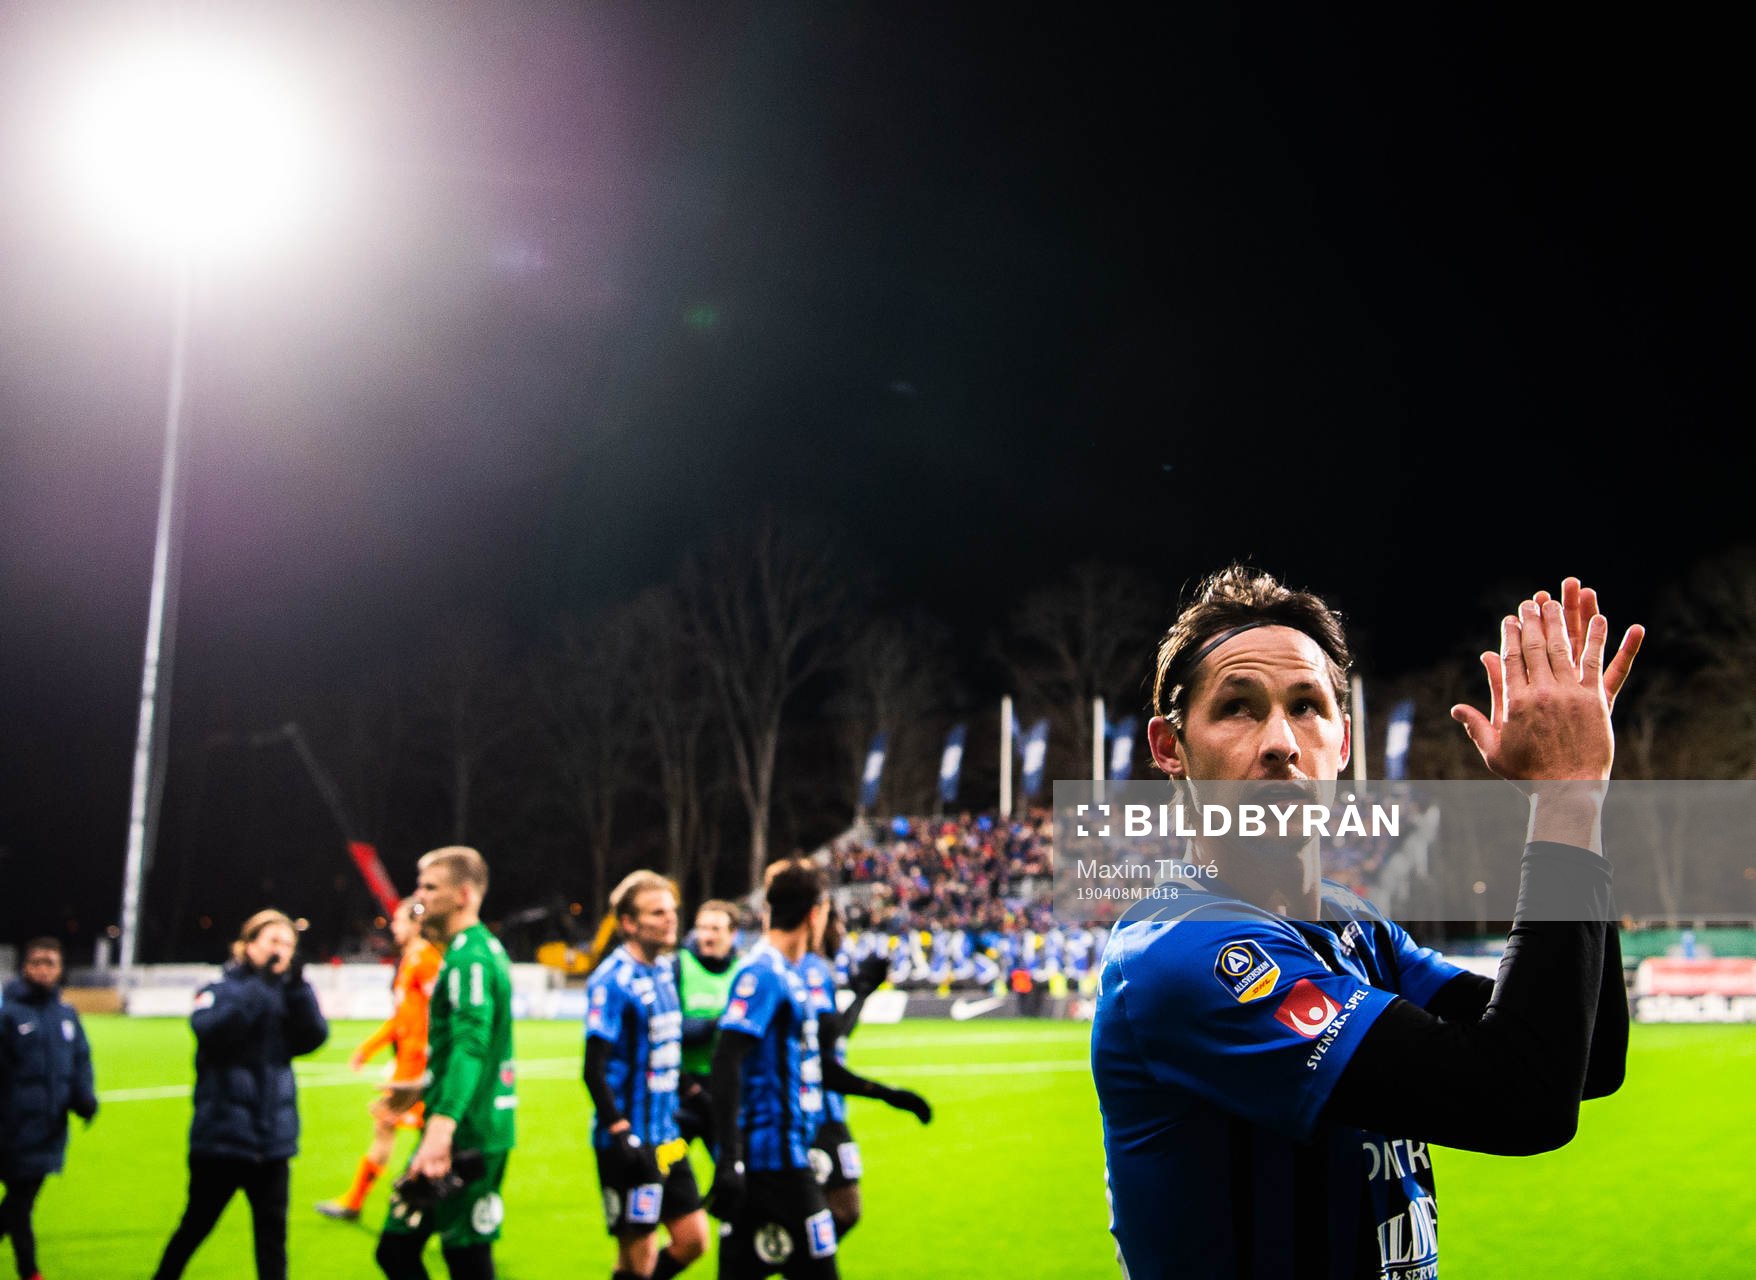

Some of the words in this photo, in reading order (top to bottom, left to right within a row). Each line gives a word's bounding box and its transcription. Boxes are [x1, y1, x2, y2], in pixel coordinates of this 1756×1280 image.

[1233, 960, 1271, 993] ALLSVENSKAN
[1251, 978, 1272, 996] DHL
[1306, 1012, 1351, 1071] SVENSKA
[1344, 989, 1369, 1011] SPEL
